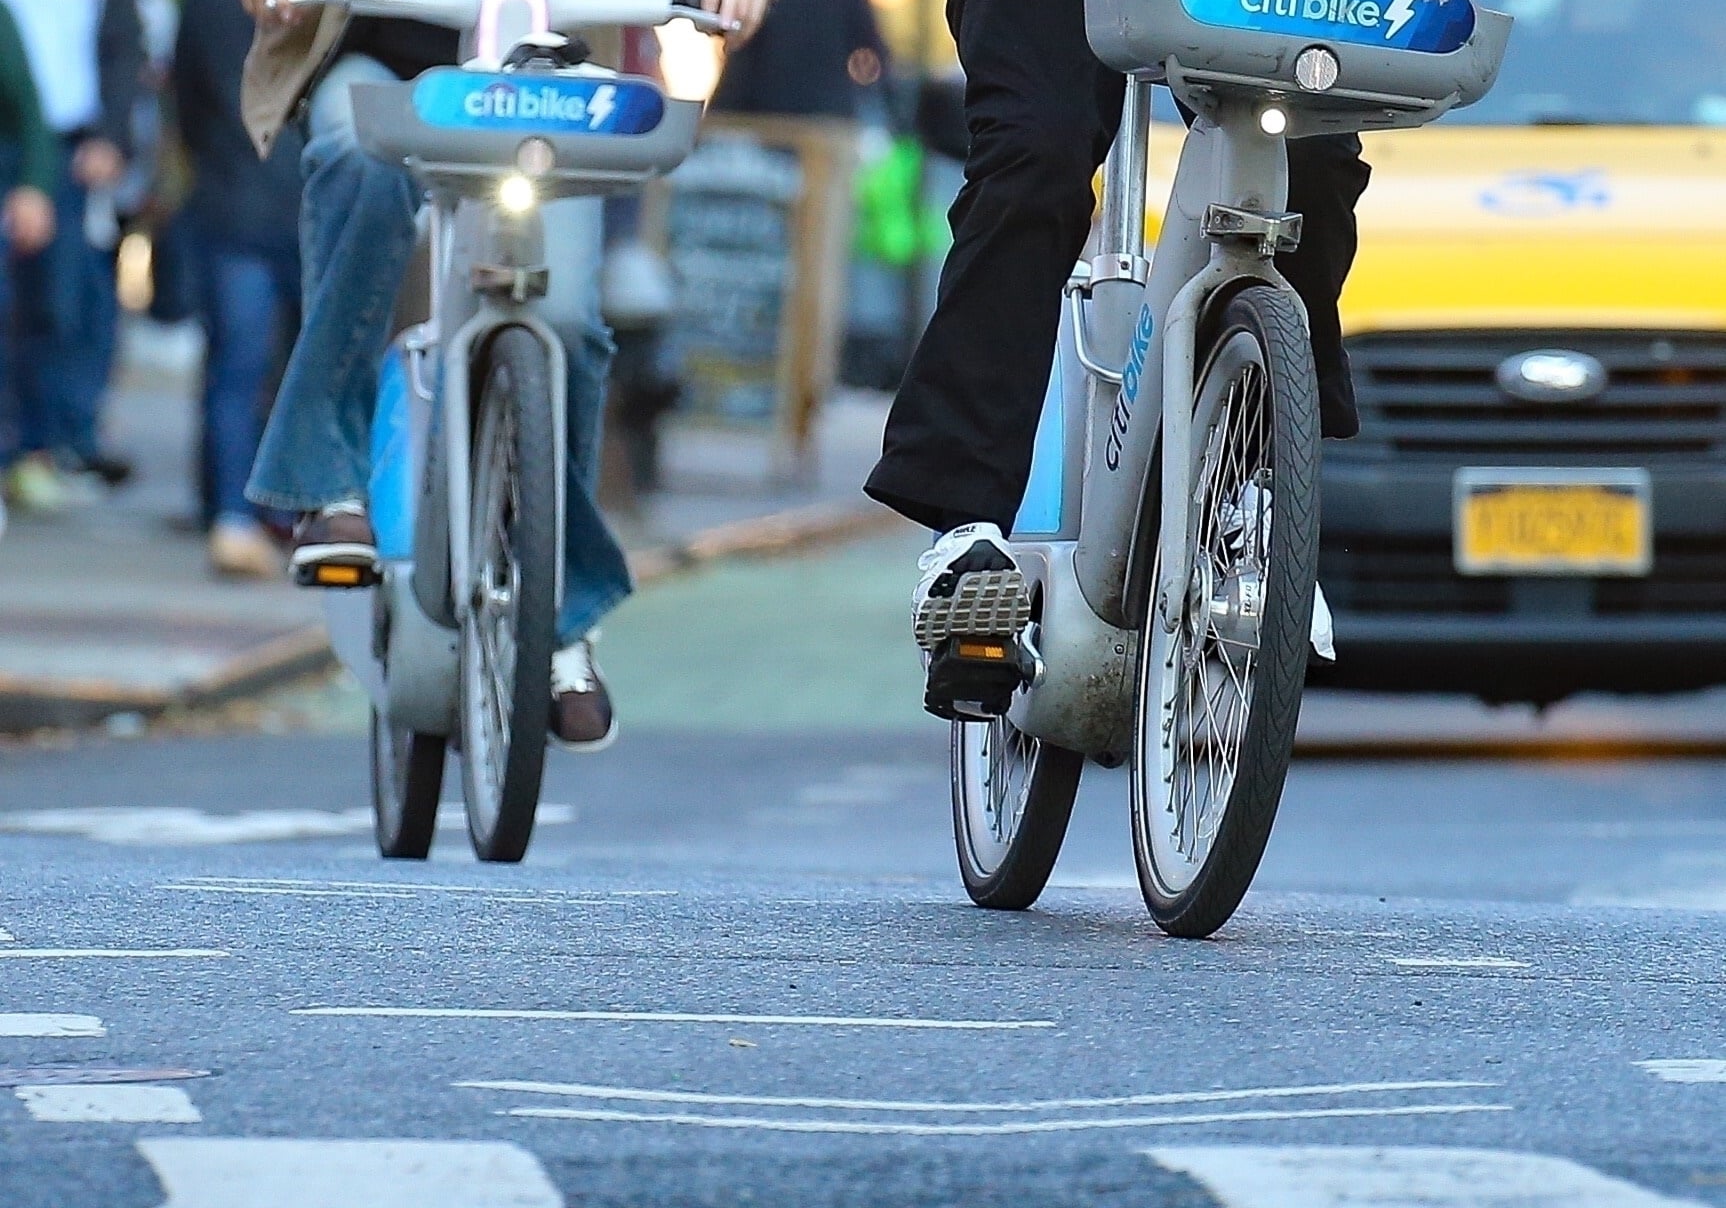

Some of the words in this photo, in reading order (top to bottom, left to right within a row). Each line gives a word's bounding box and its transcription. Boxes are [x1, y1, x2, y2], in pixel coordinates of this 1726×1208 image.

[464, 87, 516, 118] citi
[517, 86, 586, 121] bike
[1105, 391, 1131, 472] citi
